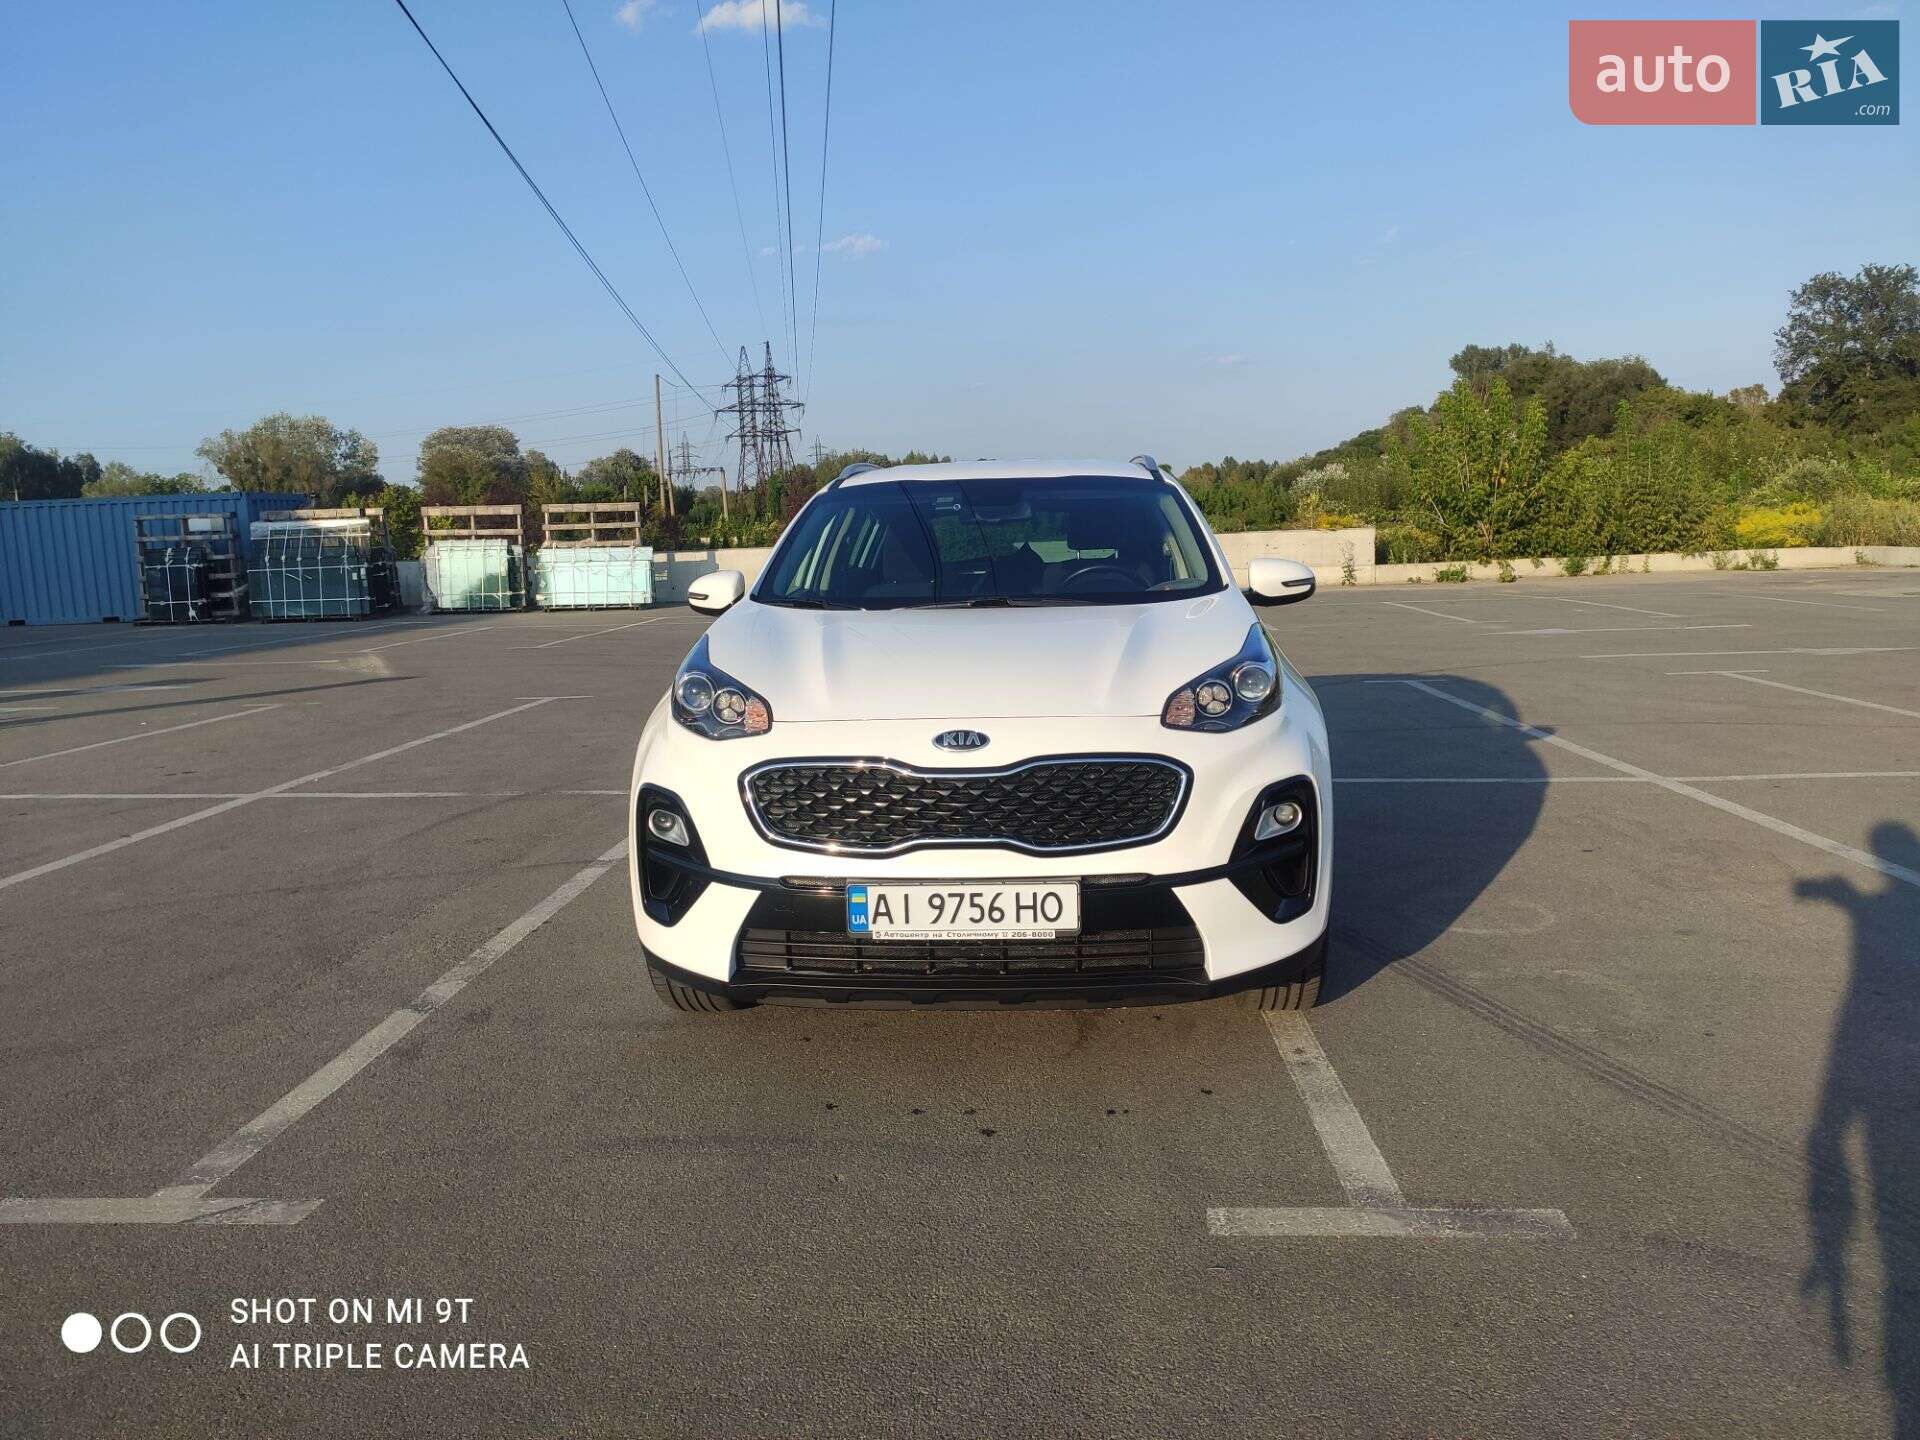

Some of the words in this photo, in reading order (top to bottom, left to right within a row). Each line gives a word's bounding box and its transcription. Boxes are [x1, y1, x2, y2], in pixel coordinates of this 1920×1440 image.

[943, 732, 981, 746] KIA
[872, 893, 909, 925] AI
[927, 892, 1005, 925] 9756
[1015, 891, 1063, 923] HO
[851, 915, 867, 925] UA
[946, 931, 999, 939] Столичному
